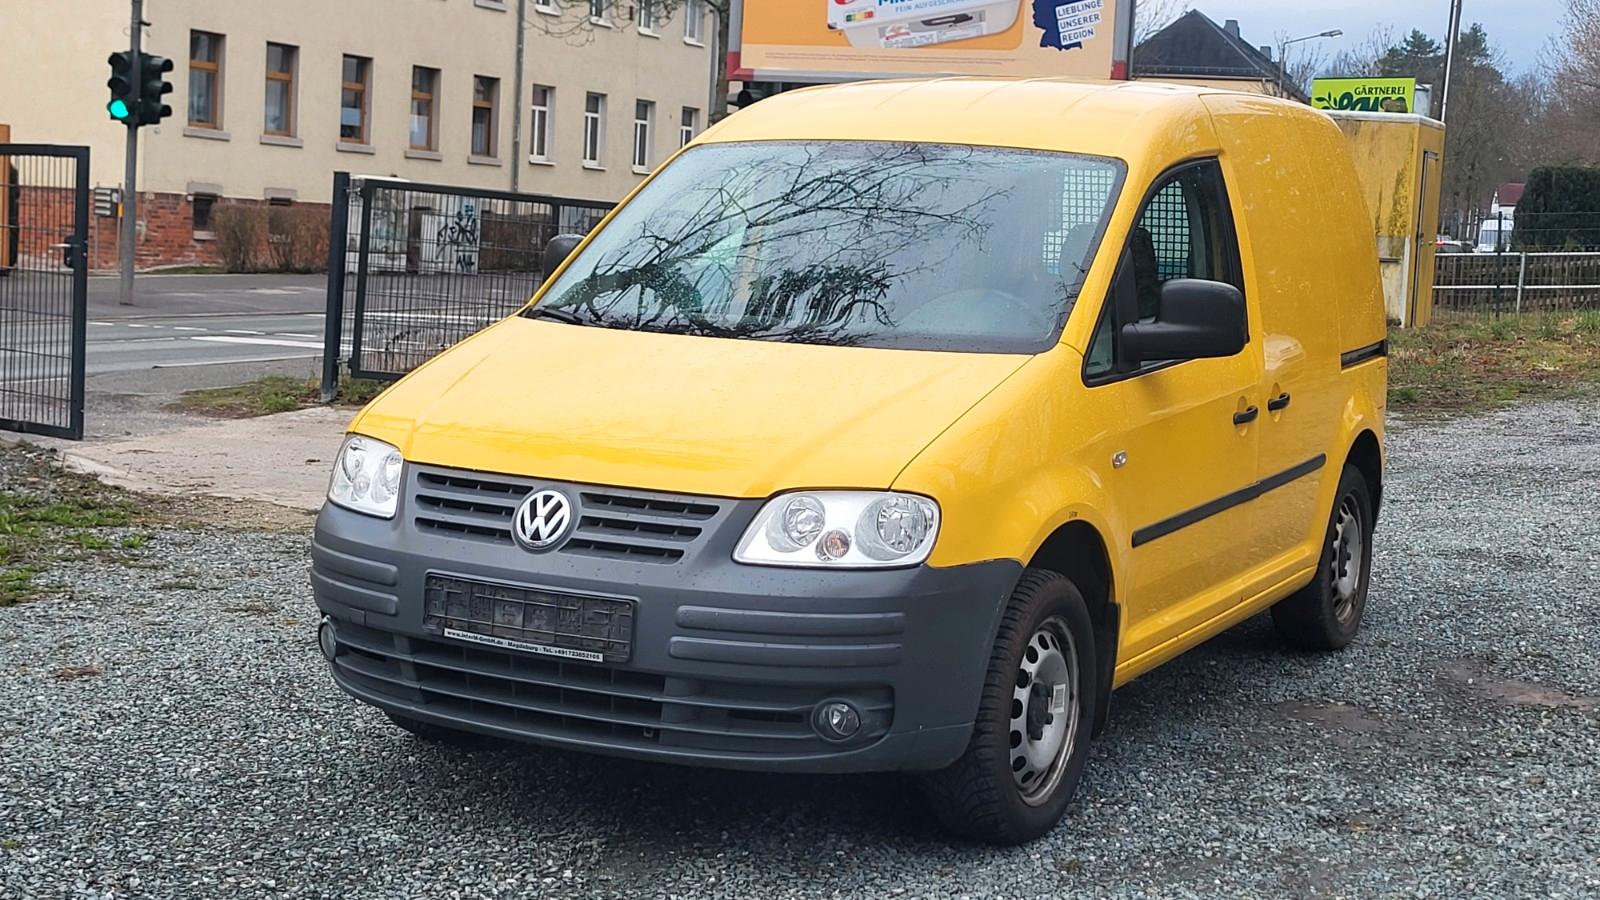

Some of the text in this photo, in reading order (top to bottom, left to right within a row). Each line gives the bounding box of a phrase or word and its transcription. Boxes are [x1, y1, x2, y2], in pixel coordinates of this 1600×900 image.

[1057, 0, 1103, 16] LIEBLINGE
[1060, 13, 1100, 30] UNSERER
[1062, 28, 1094, 42] REGION
[1354, 85, 1405, 95] GÄRTNEREI
[517, 491, 569, 544] VW
